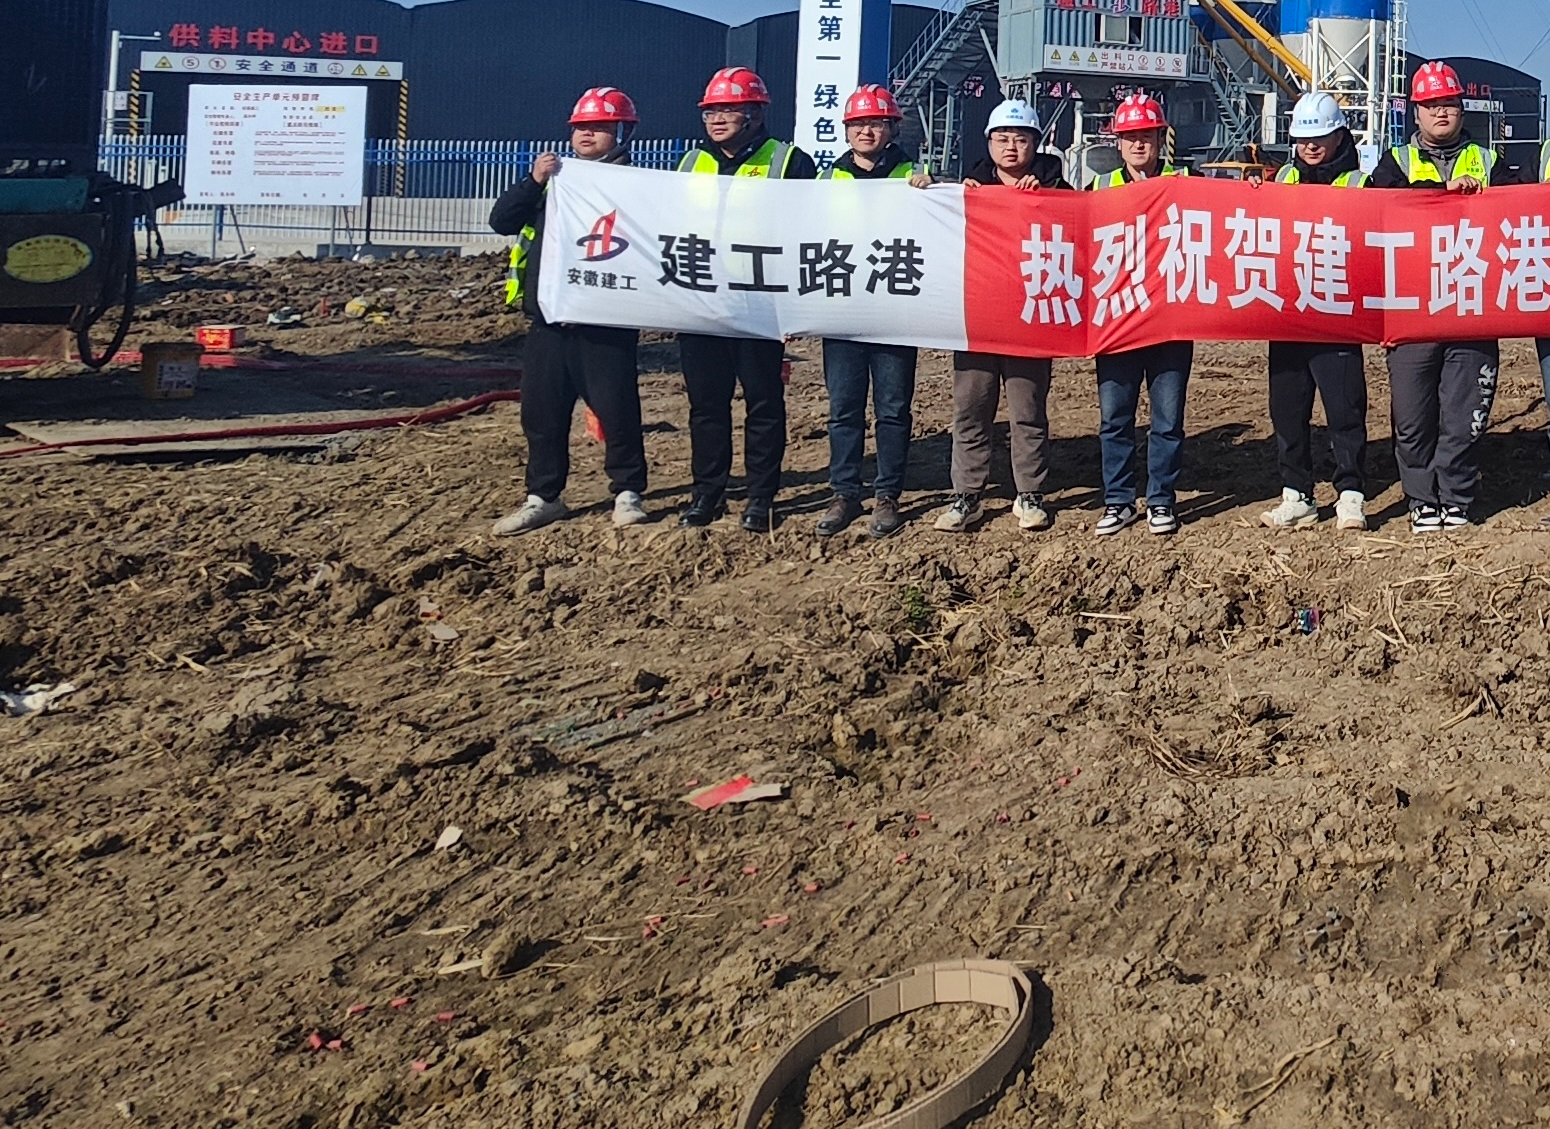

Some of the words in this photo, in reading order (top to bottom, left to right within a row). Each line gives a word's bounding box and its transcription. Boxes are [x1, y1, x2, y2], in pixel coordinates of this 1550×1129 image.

[168, 23, 379, 54] 供料中心进口
[235, 58, 319, 74] 安全通道
[567, 267, 638, 291] 安徽建工
[657, 233, 925, 298] 建工路港
